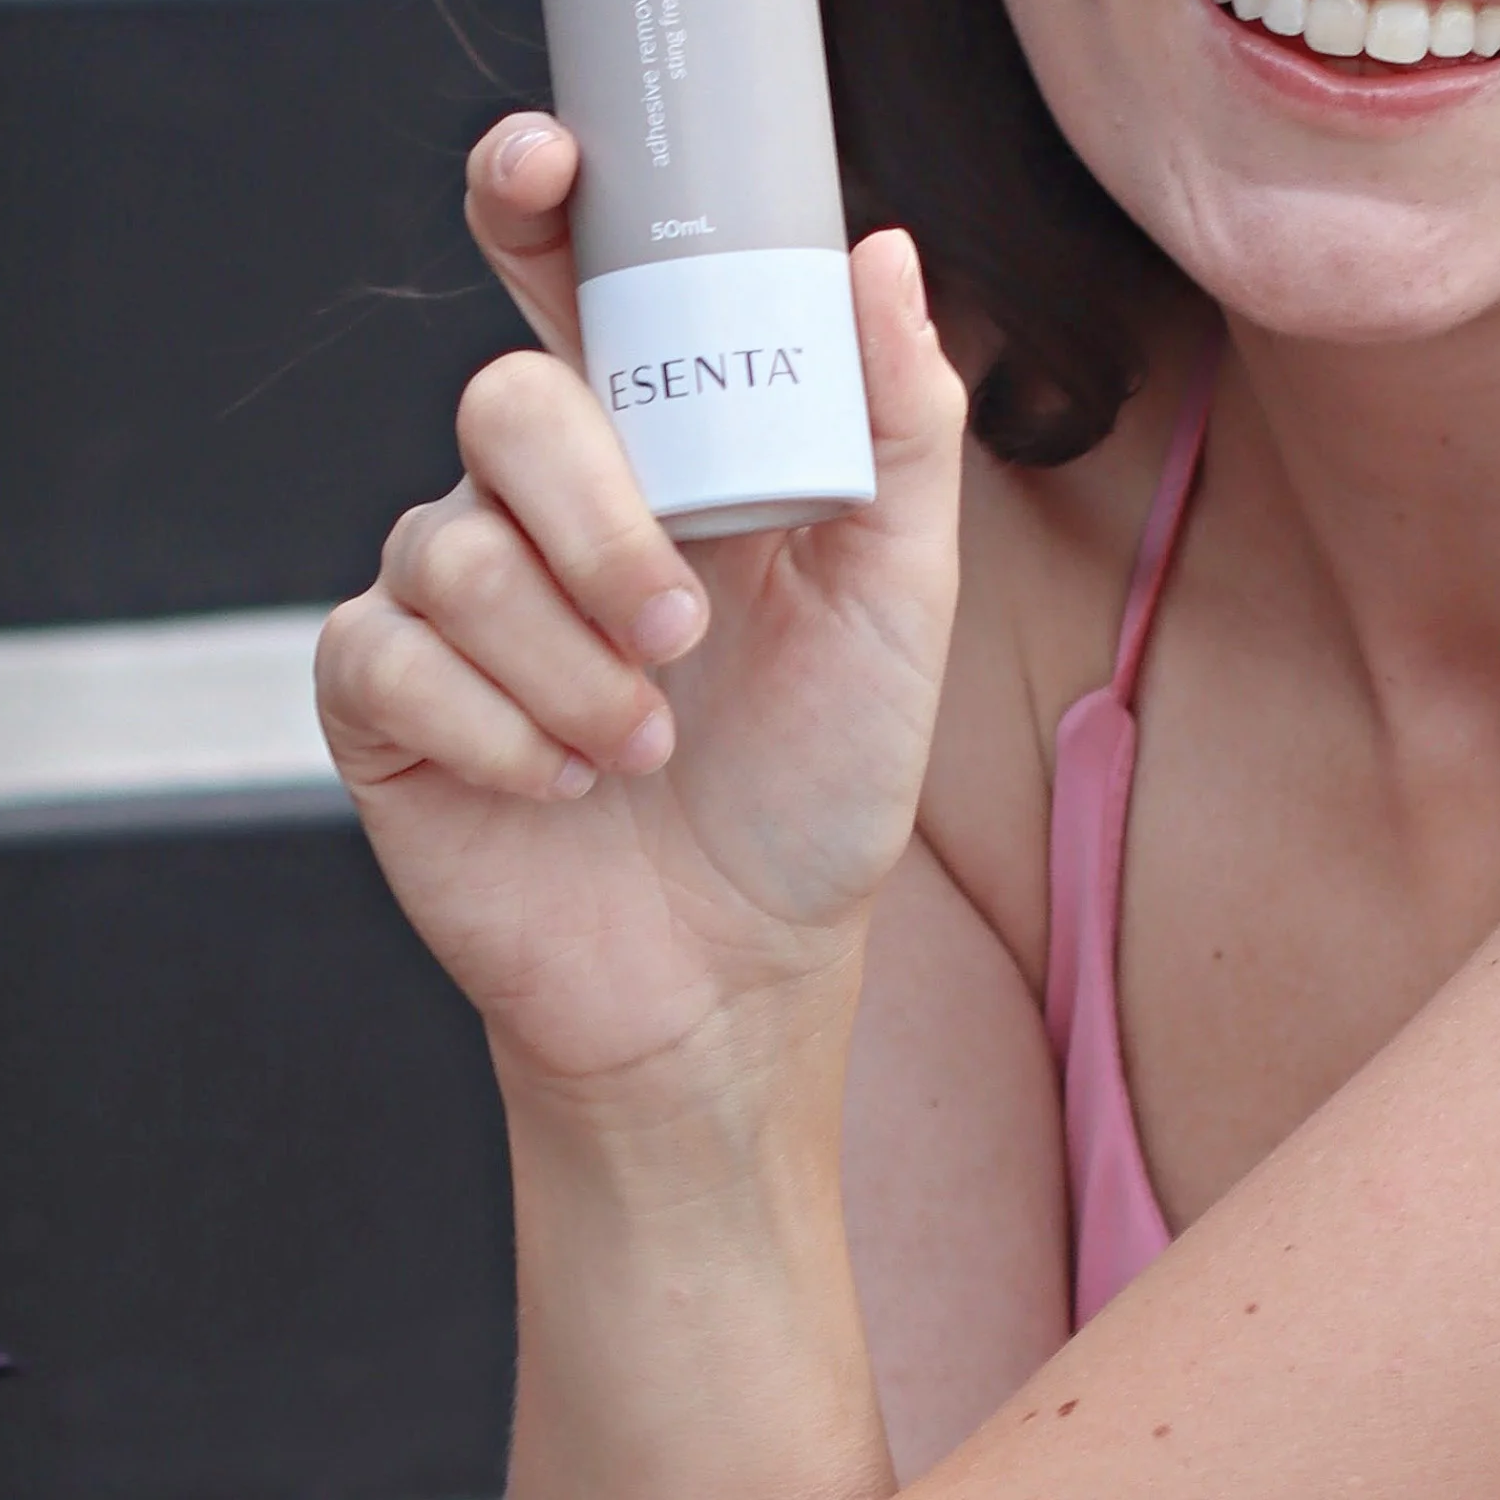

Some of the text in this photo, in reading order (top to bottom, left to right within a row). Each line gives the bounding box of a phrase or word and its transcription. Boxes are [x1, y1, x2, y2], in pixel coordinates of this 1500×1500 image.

[664, 28, 688, 80] sting
[641, 70, 671, 167] adhesive
[651, 215, 716, 241] 50mL
